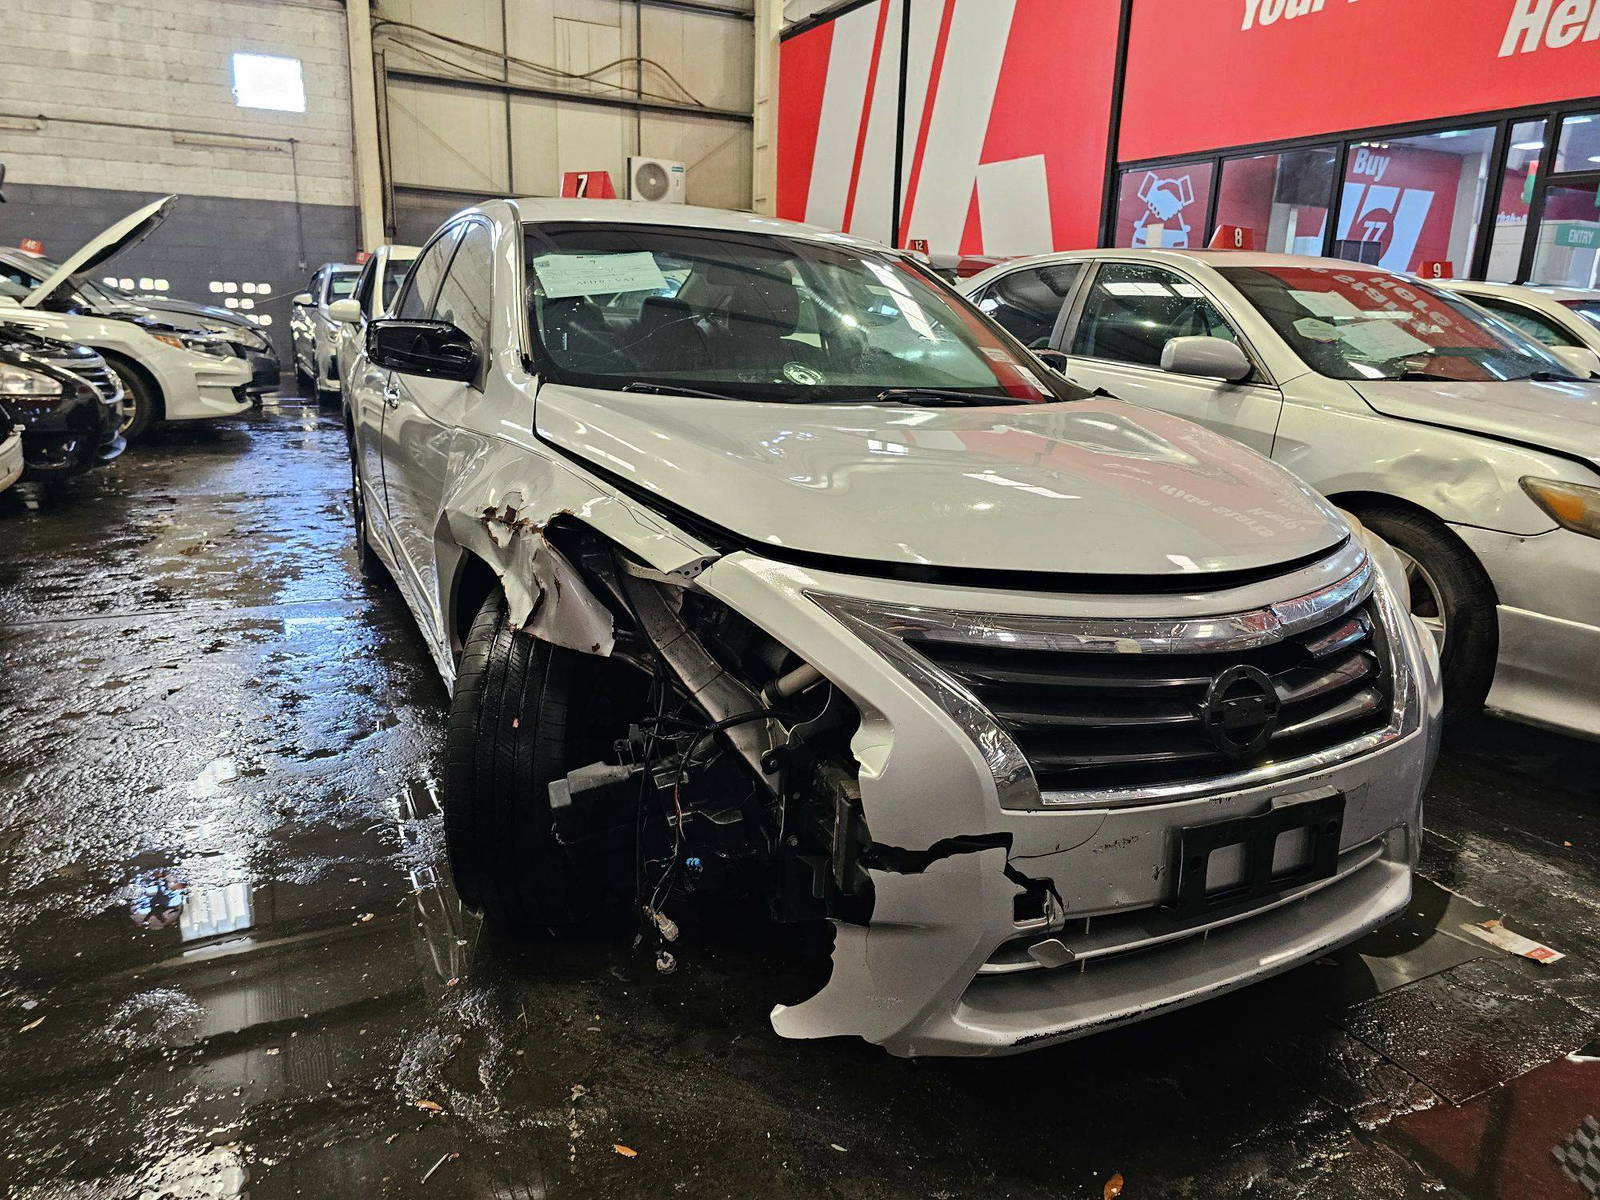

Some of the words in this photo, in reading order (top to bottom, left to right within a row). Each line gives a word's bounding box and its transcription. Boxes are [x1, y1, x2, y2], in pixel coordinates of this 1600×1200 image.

[1353, 148, 1391, 182] Buy
[577, 174, 588, 198] 7
[1235, 227, 1242, 247] 8
[1362, 220, 1388, 241] 77
[1567, 229, 1594, 244] ENTRY
[915, 240, 923, 250] 12
[1433, 263, 1441, 278] 9
